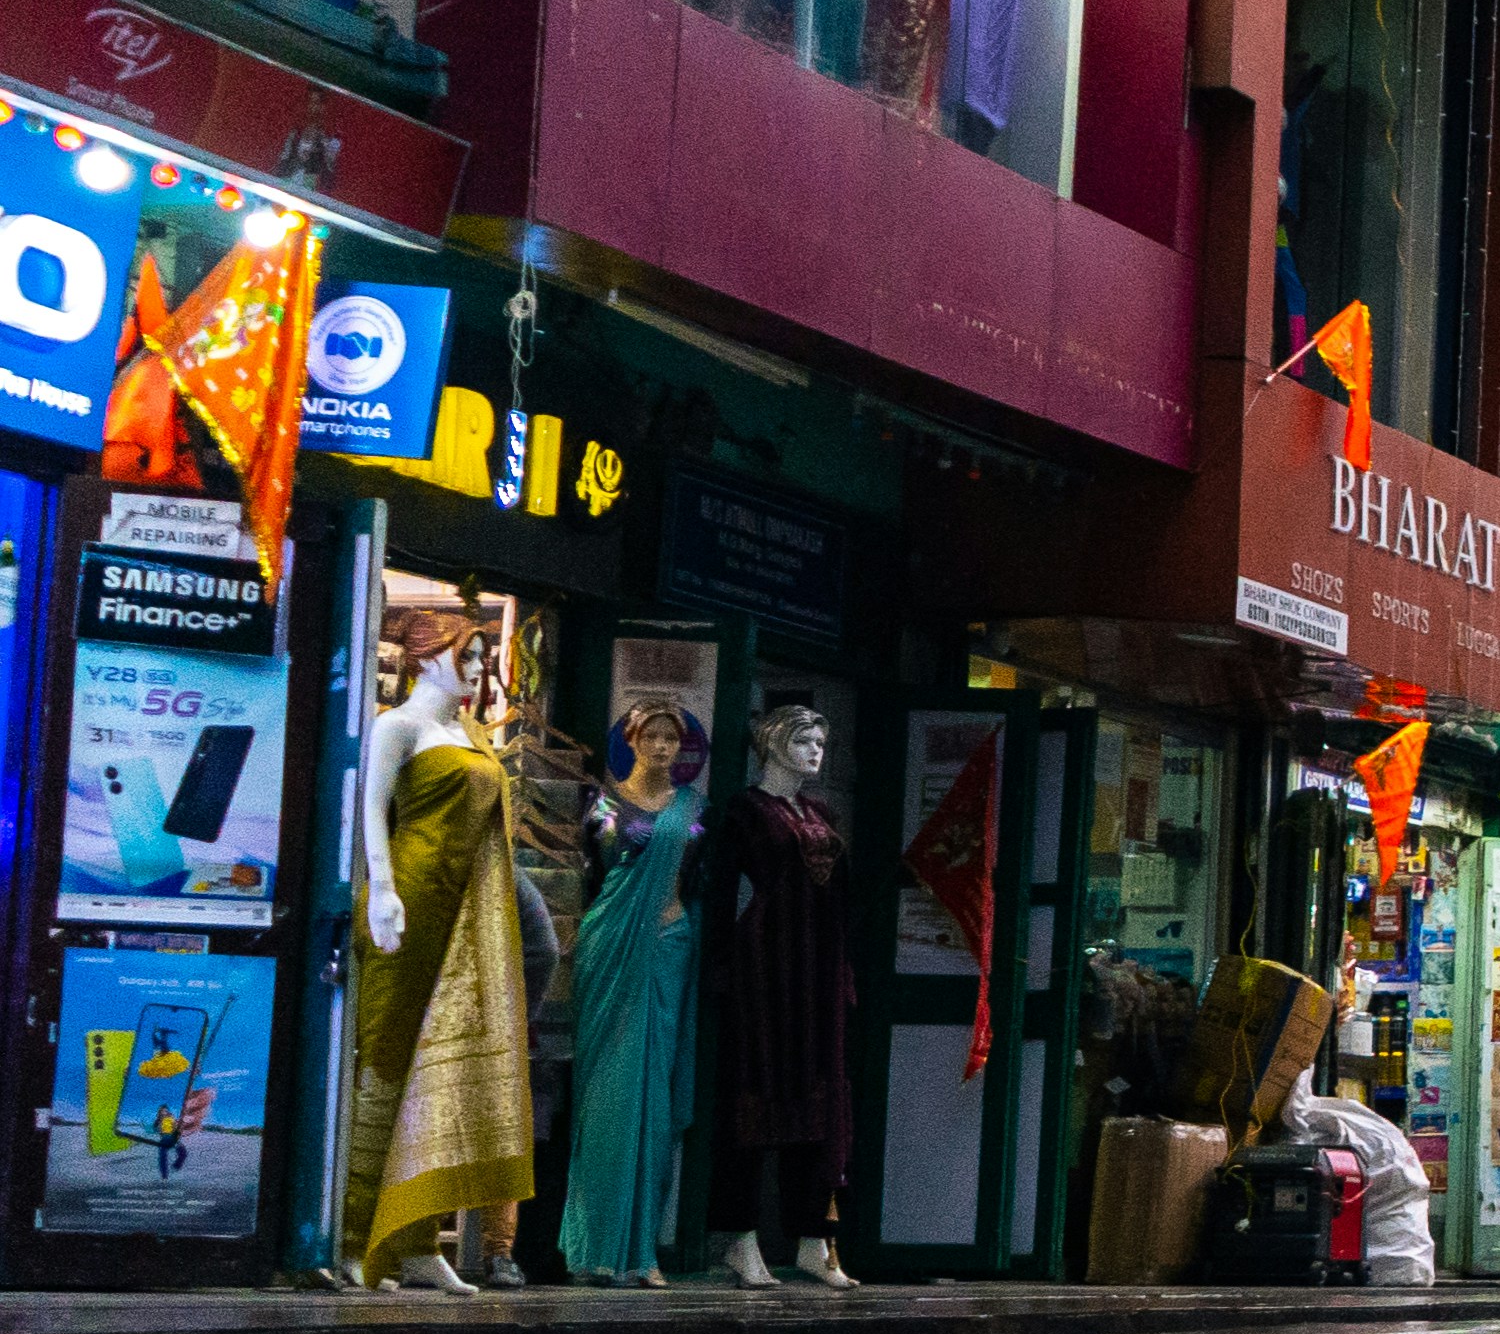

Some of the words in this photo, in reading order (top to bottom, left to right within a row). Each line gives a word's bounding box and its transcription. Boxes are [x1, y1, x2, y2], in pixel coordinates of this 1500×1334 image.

[0, 203, 107, 343] O
[31, 377, 92, 416] House
[301, 396, 393, 421] NOKIA
[298, 421, 391, 439] martphones
[431, 385, 563, 517] RI
[148, 502, 217, 520] MOBILE
[129, 527, 229, 548] REPAIRING
[102, 566, 261, 603] SAMSUNG
[1291, 561, 1344, 605] SHOES
[1371, 591, 1430, 635] SPORTS
[141, 688, 204, 719] 5G
